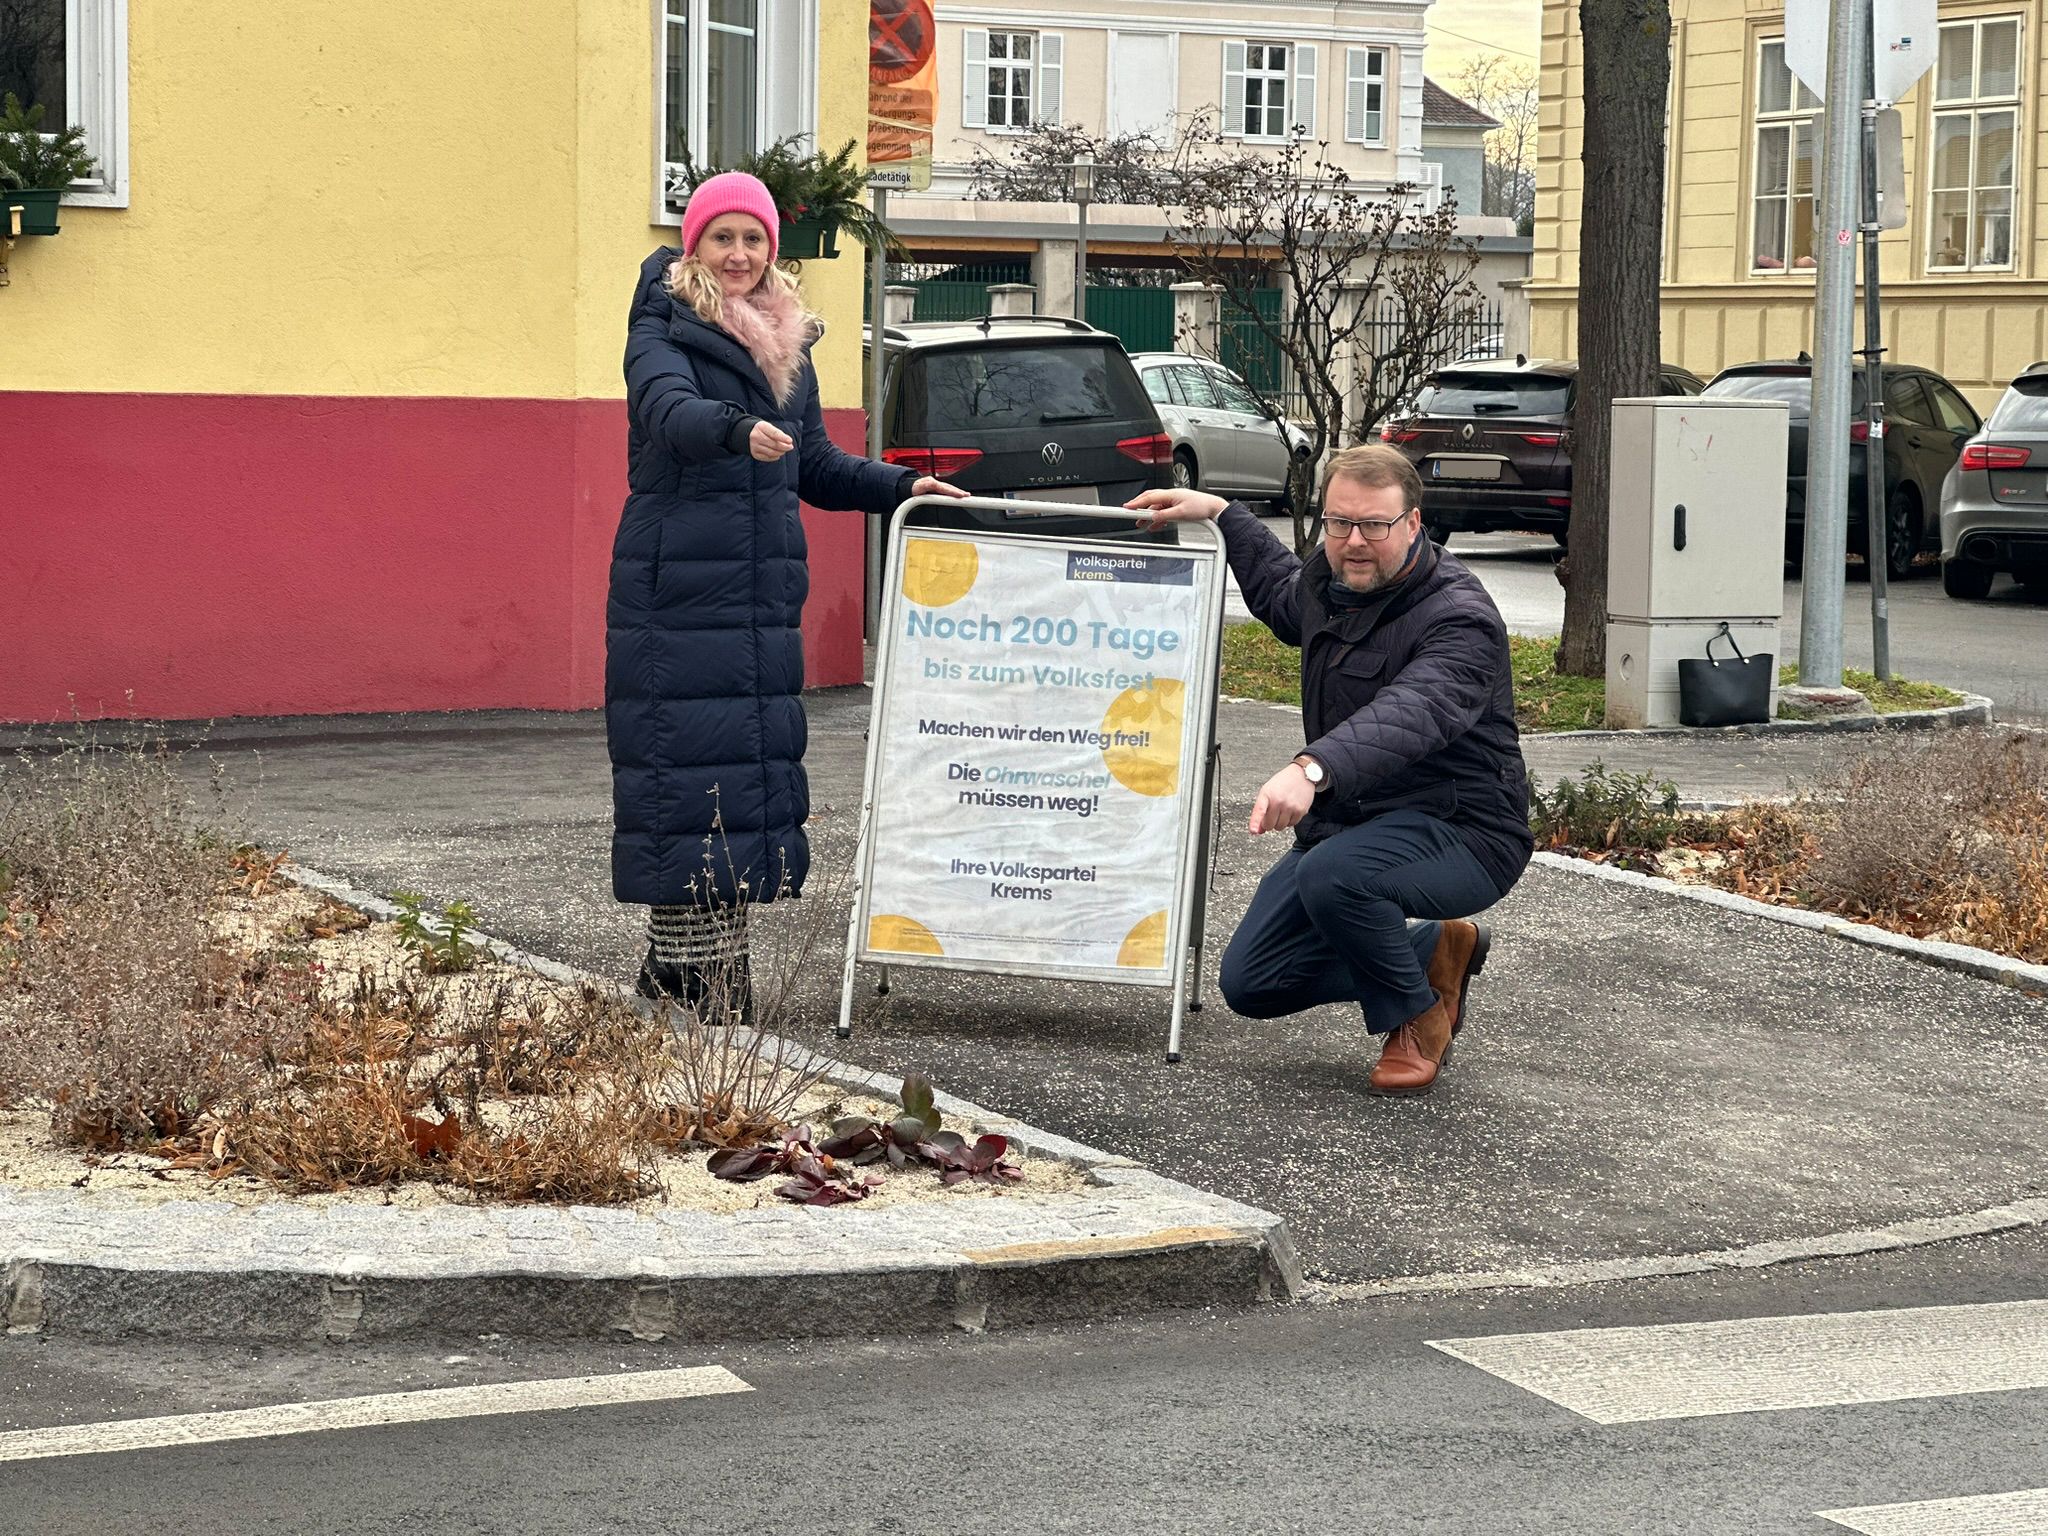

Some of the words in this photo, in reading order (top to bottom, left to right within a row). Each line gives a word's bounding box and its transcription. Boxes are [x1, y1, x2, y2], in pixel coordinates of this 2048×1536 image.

[1029, 475, 1080, 483] TOURAN
[1073, 569, 1114, 581] krems
[1075, 555, 1146, 570] volkspartei
[906, 609, 1001, 642] Noch
[1010, 615, 1078, 646] 200
[1087, 621, 1179, 660] Tage
[924, 657, 962, 679] bis
[968, 665, 1025, 685] zum
[1033, 665, 1155, 690] Volksfest
[918, 719, 994, 739] Machen
[997, 724, 1027, 741] wir
[1029, 726, 1065, 743] den
[1068, 728, 1111, 750] Weg
[1114, 730, 1150, 748] frei!
[948, 763, 982, 782] Die
[984, 765, 1111, 788] Ohrwaschel
[958, 789, 1043, 810] müssen
[1047, 794, 1099, 817] weg!
[950, 858, 987, 875] Ihre
[989, 861, 1096, 884] Volkspartei
[990, 882, 1053, 900] Krems
